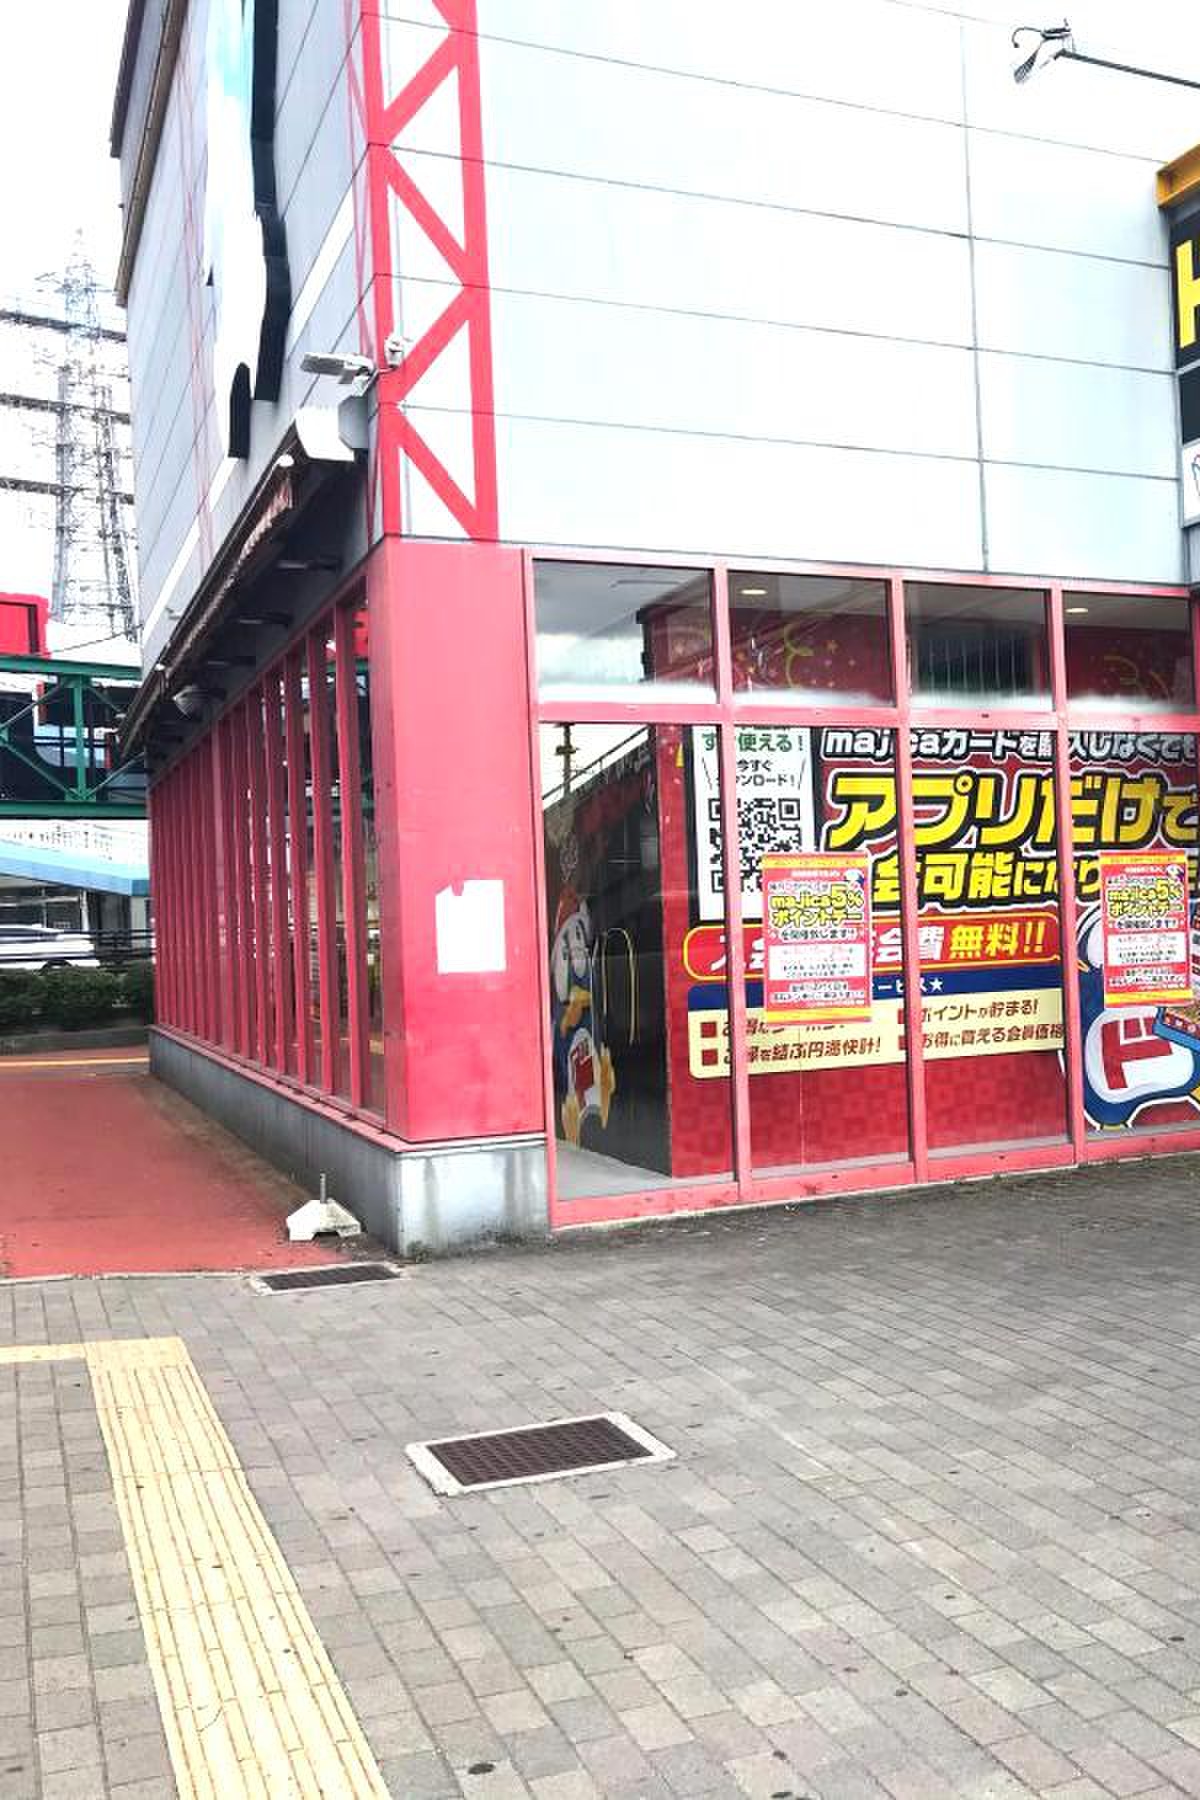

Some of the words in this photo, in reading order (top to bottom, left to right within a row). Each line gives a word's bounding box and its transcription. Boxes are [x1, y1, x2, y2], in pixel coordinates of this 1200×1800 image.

[828, 774, 1198, 847] アプリだけで
